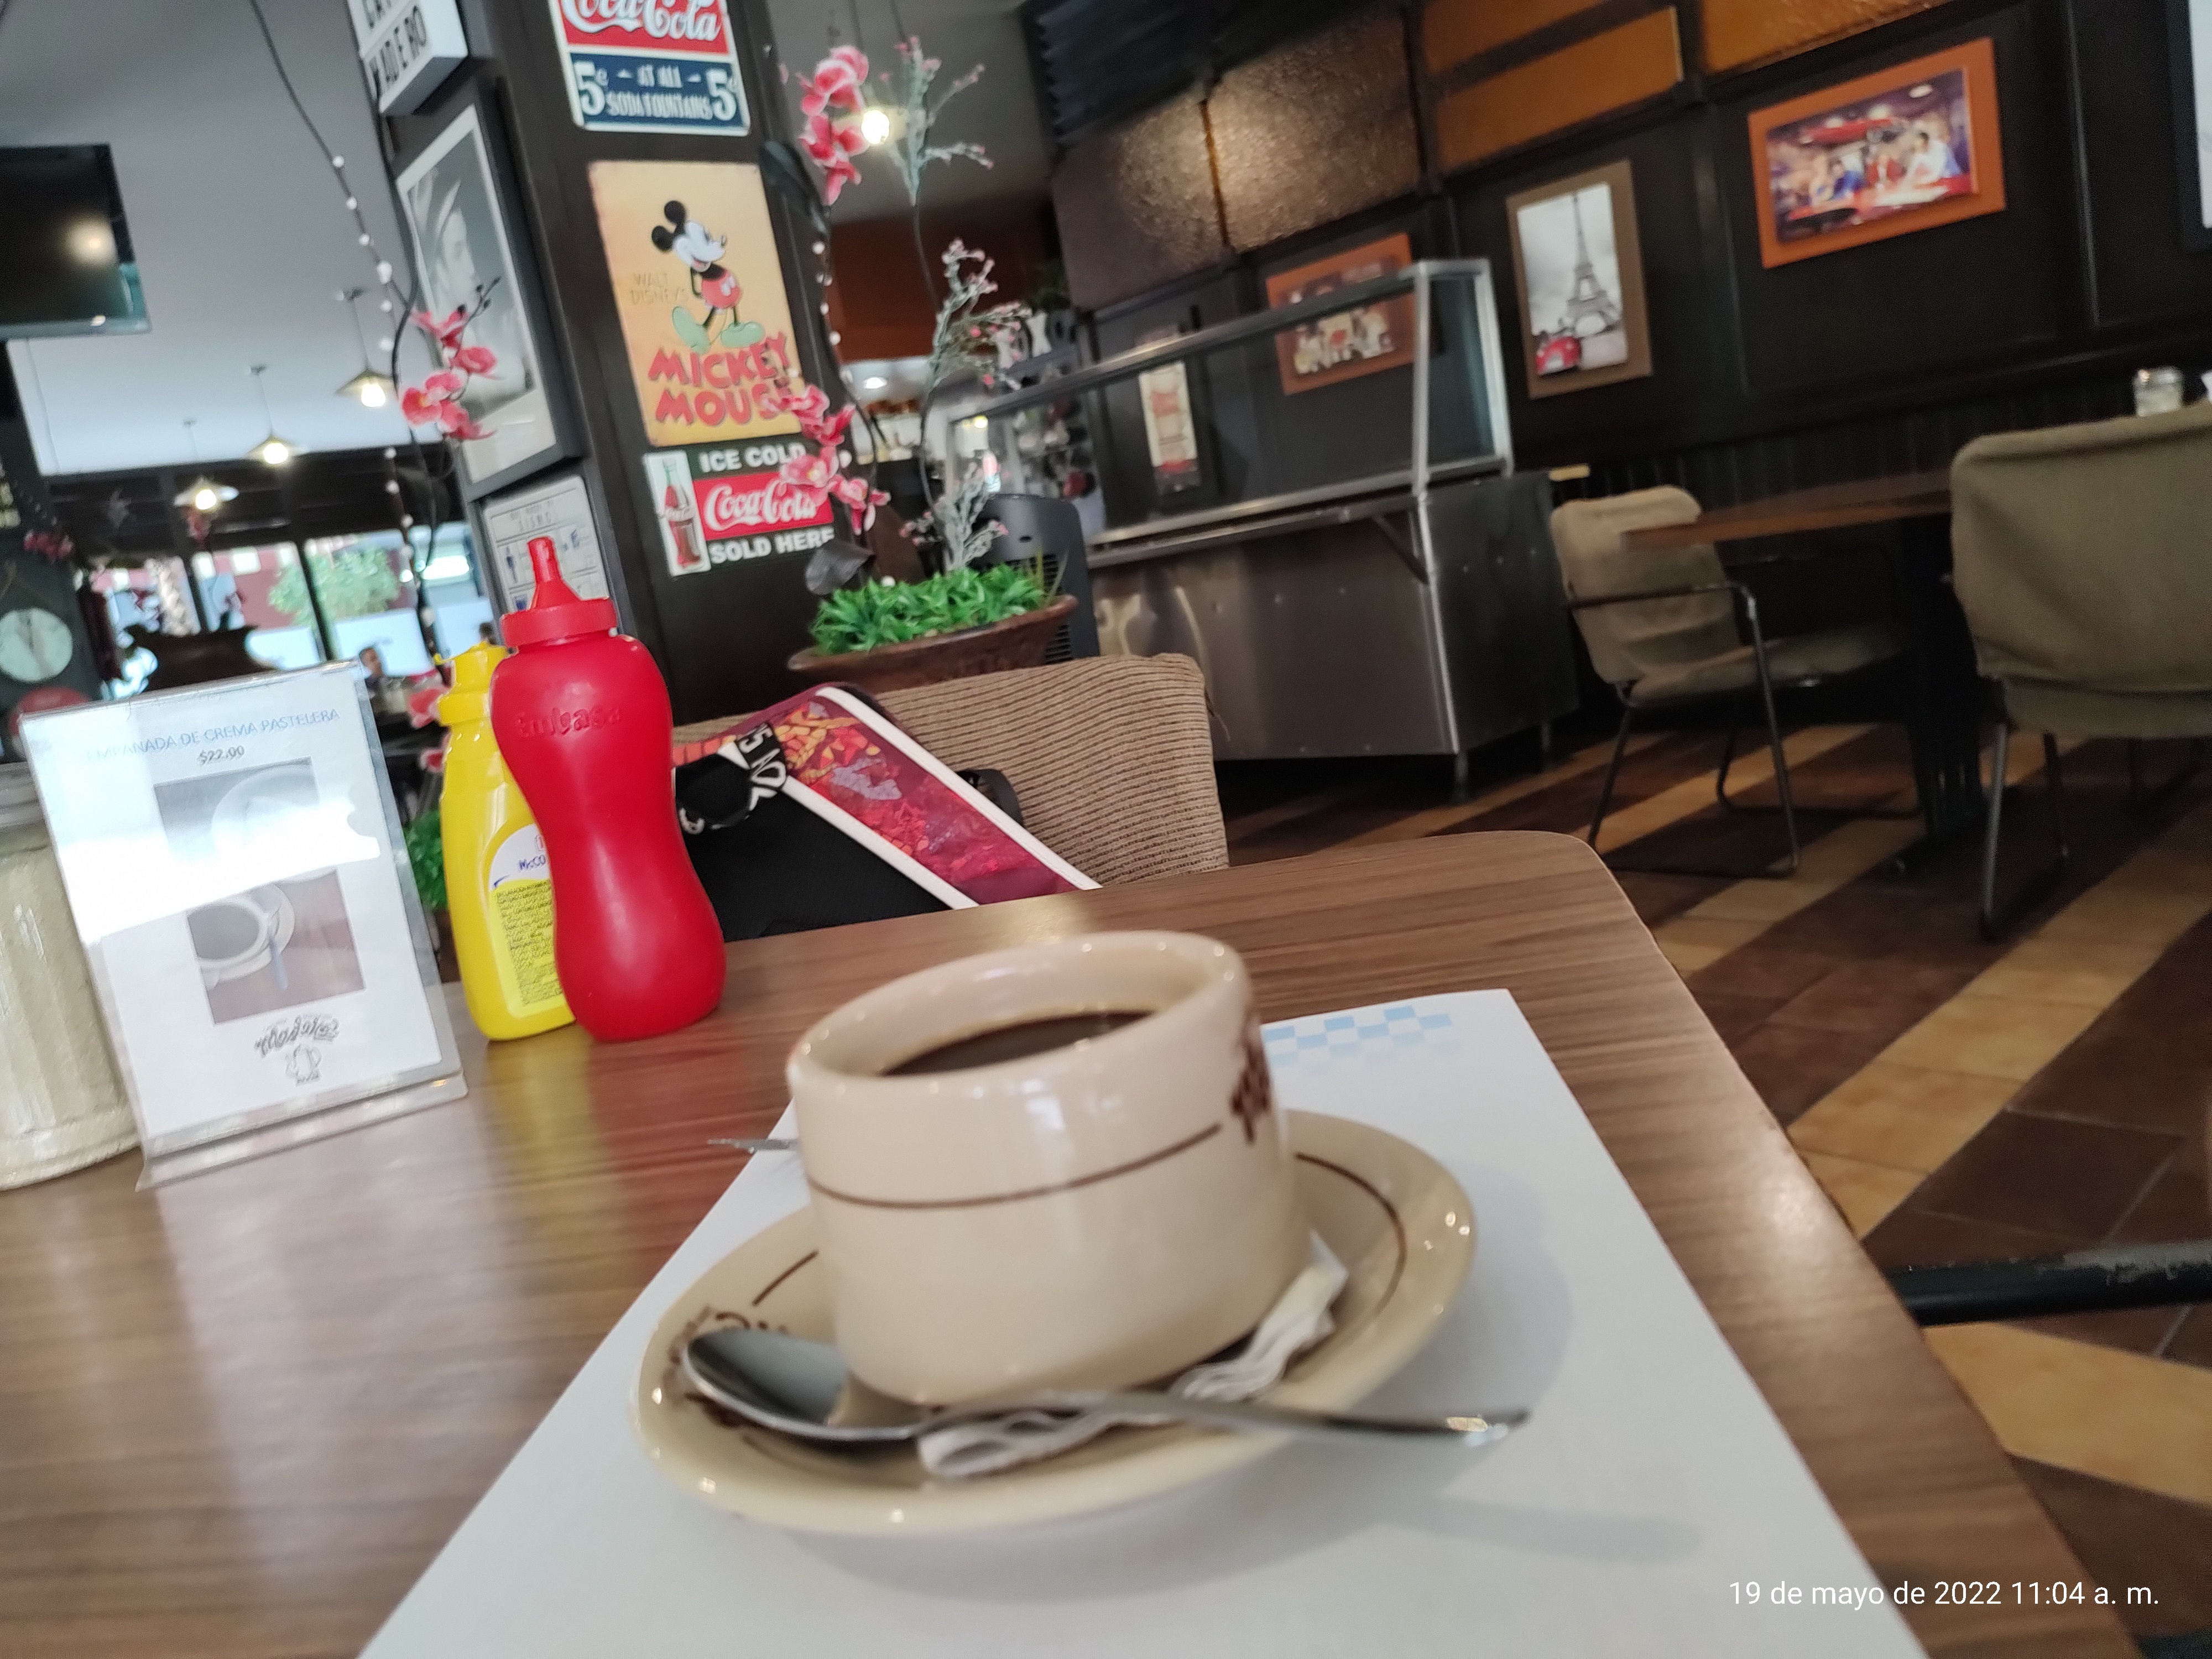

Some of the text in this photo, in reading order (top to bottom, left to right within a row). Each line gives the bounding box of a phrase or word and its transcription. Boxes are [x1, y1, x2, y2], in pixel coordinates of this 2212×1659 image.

[648, 331, 790, 388] MICKEY
[698, 450, 742, 473] ICE
[708, 536, 772, 564] SOLD
[180, 731, 200, 746] DE
[204, 721, 258, 742] CREMA
[260, 708, 341, 732] PASTELERA
